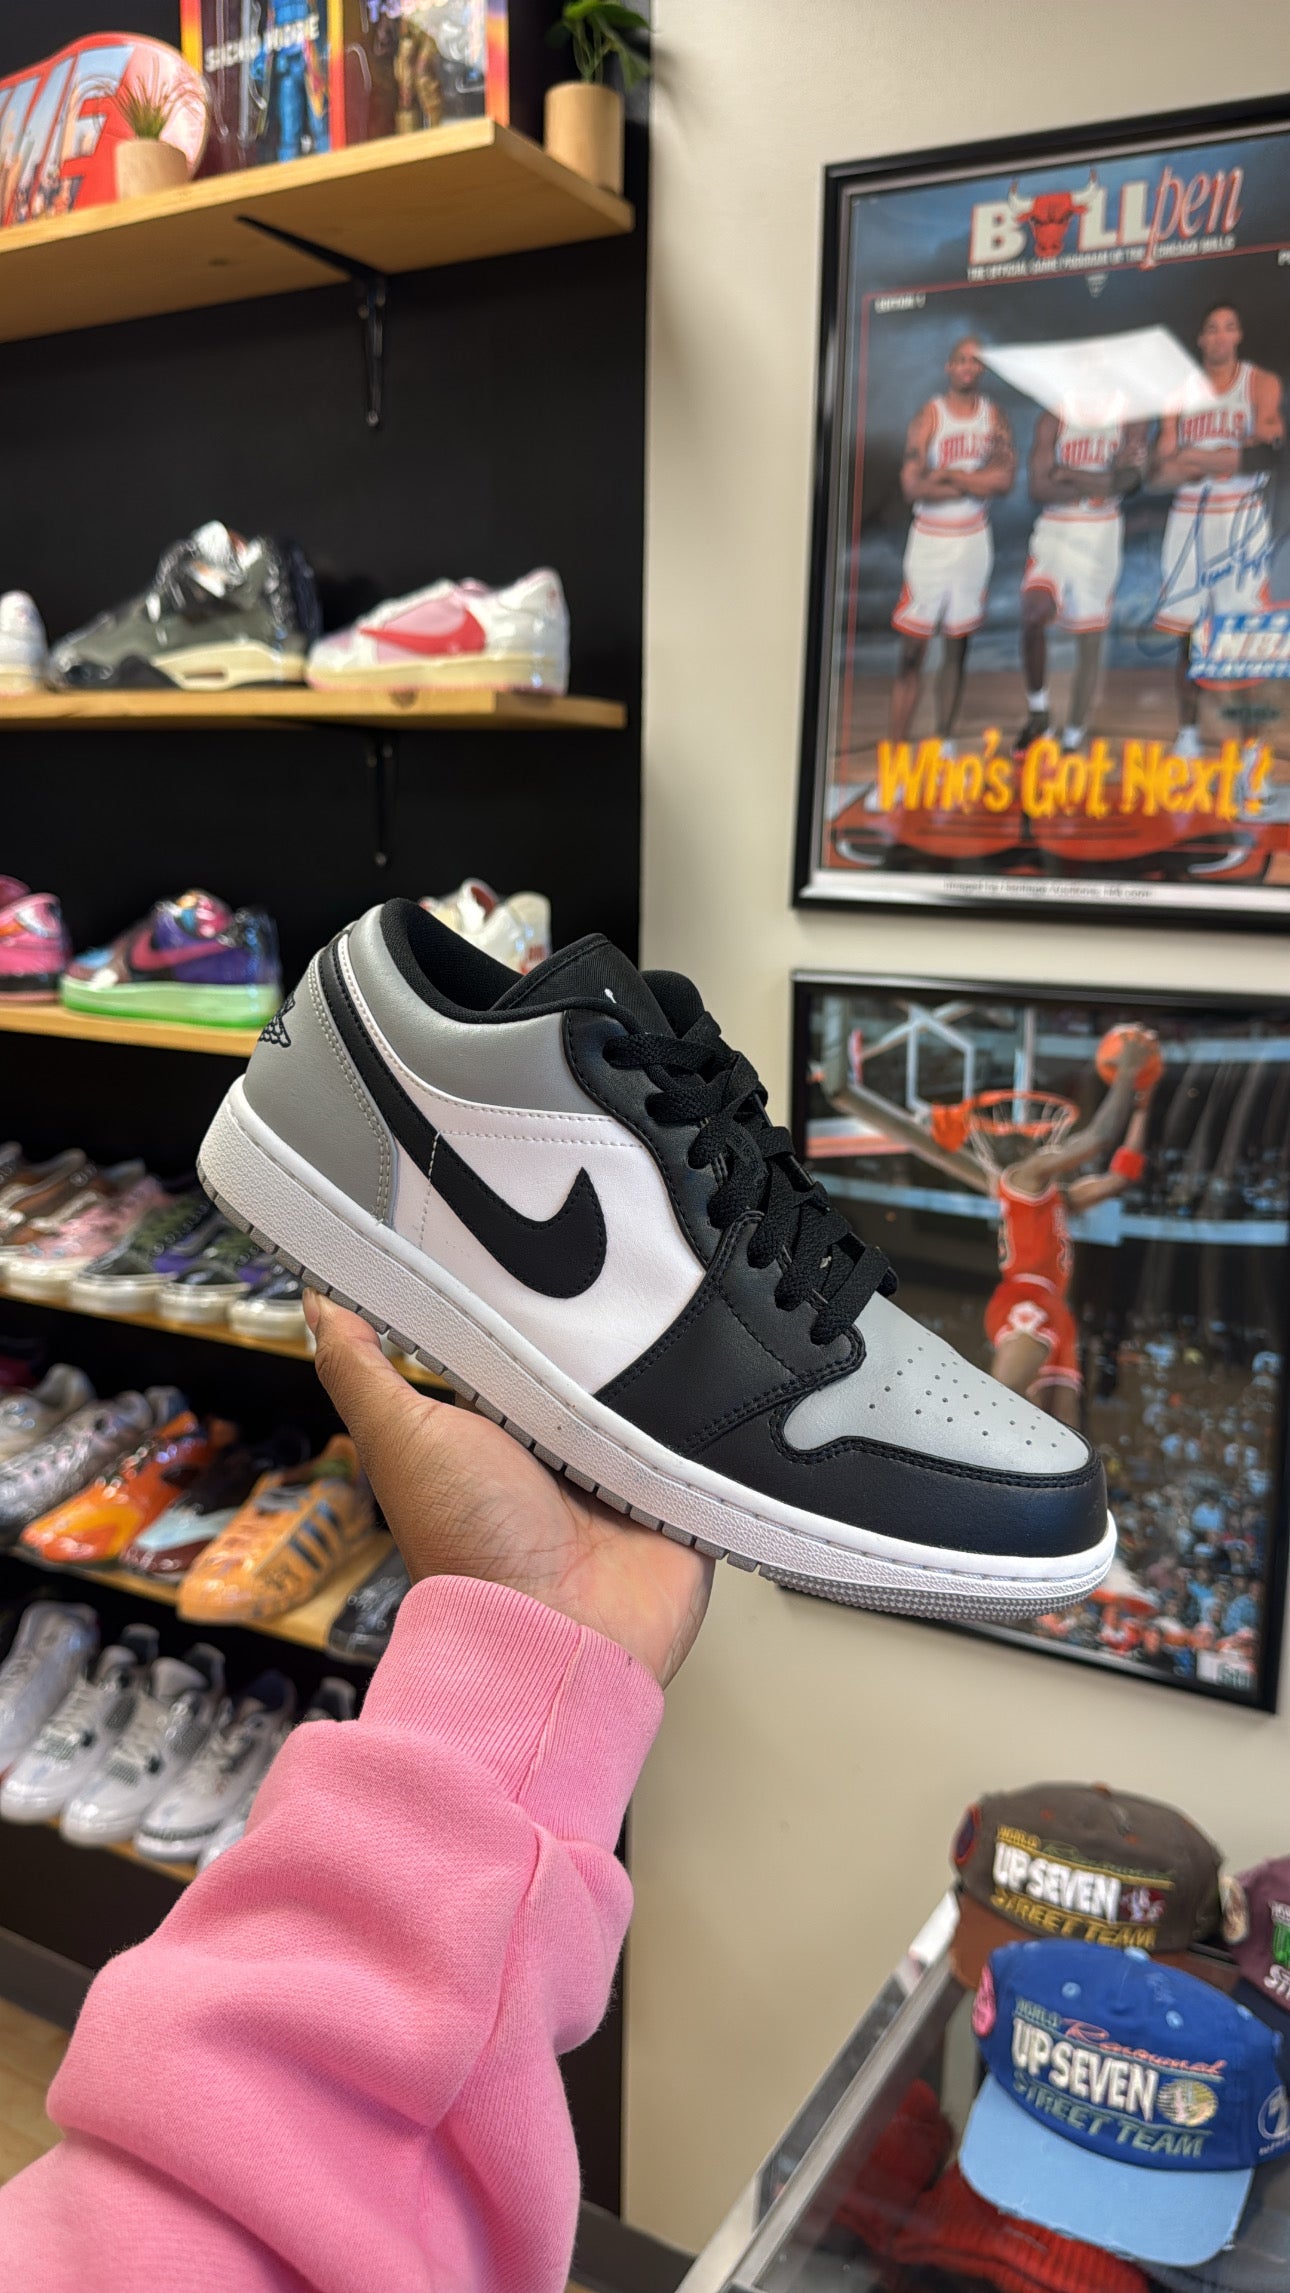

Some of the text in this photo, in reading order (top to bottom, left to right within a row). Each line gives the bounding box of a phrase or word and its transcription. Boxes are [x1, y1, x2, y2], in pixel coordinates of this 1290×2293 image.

[877, 727, 1014, 813] Who's
[1022, 736, 1114, 819] Got
[990, 1887, 1158, 1949] STREET TEAM
[1013, 2071, 1206, 2159] STREET TEAM
